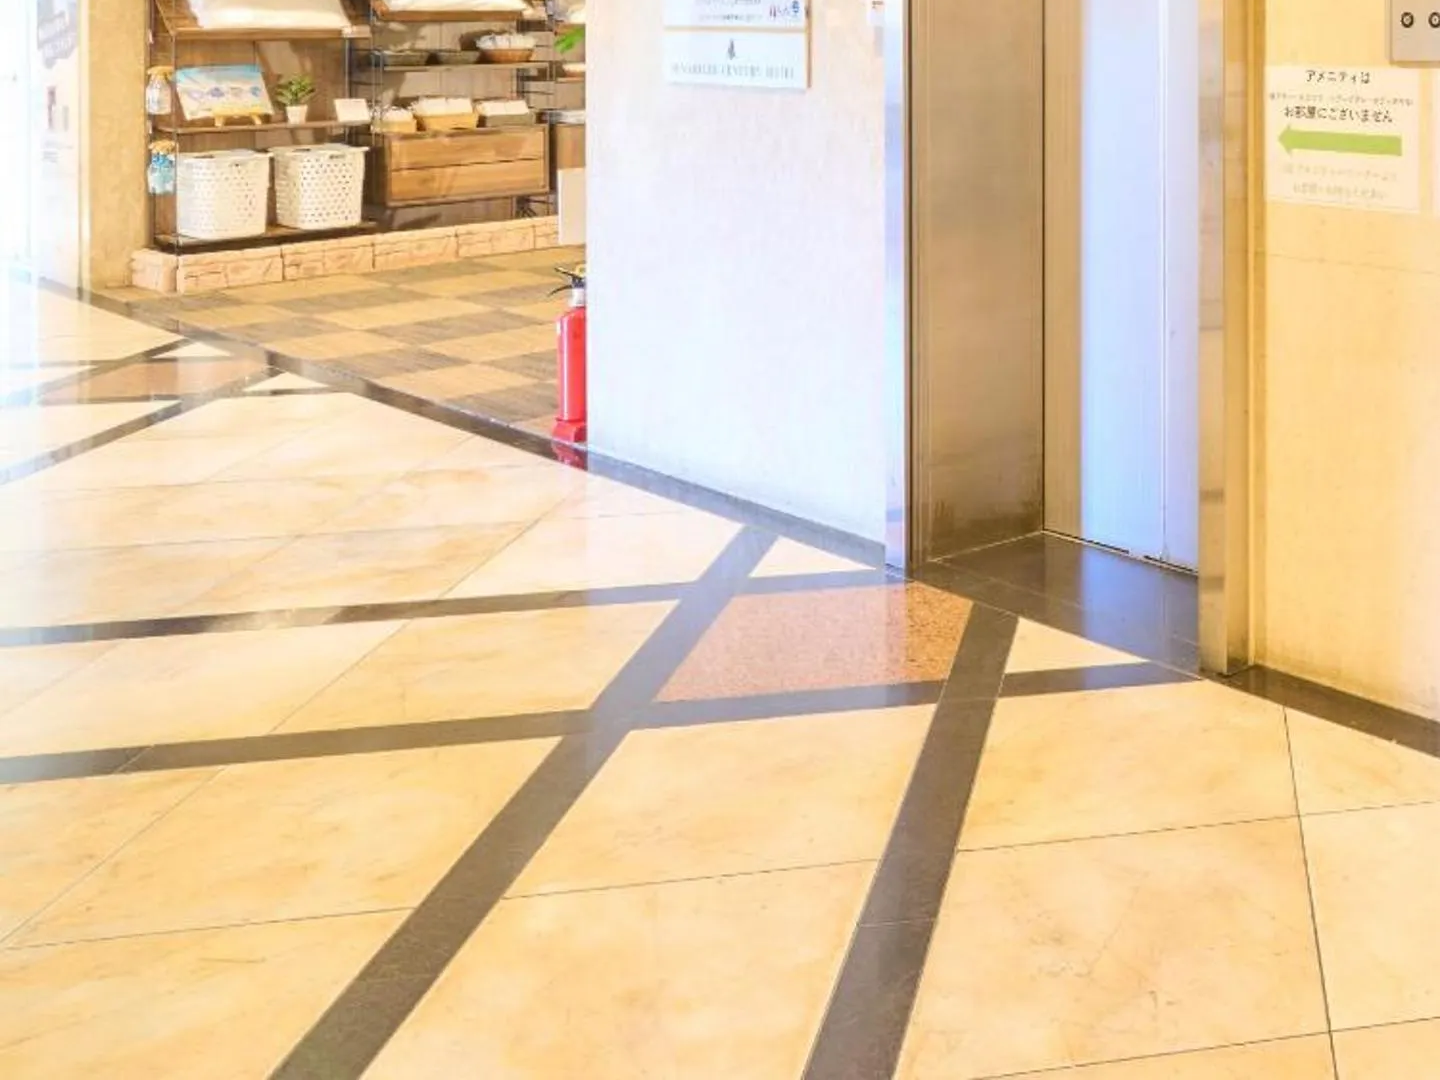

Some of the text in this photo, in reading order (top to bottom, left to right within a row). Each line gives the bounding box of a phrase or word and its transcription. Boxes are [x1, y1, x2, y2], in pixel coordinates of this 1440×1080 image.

[1305, 70, 1370, 84] アメニティは
[1284, 105, 1393, 122] お部屋にございません
